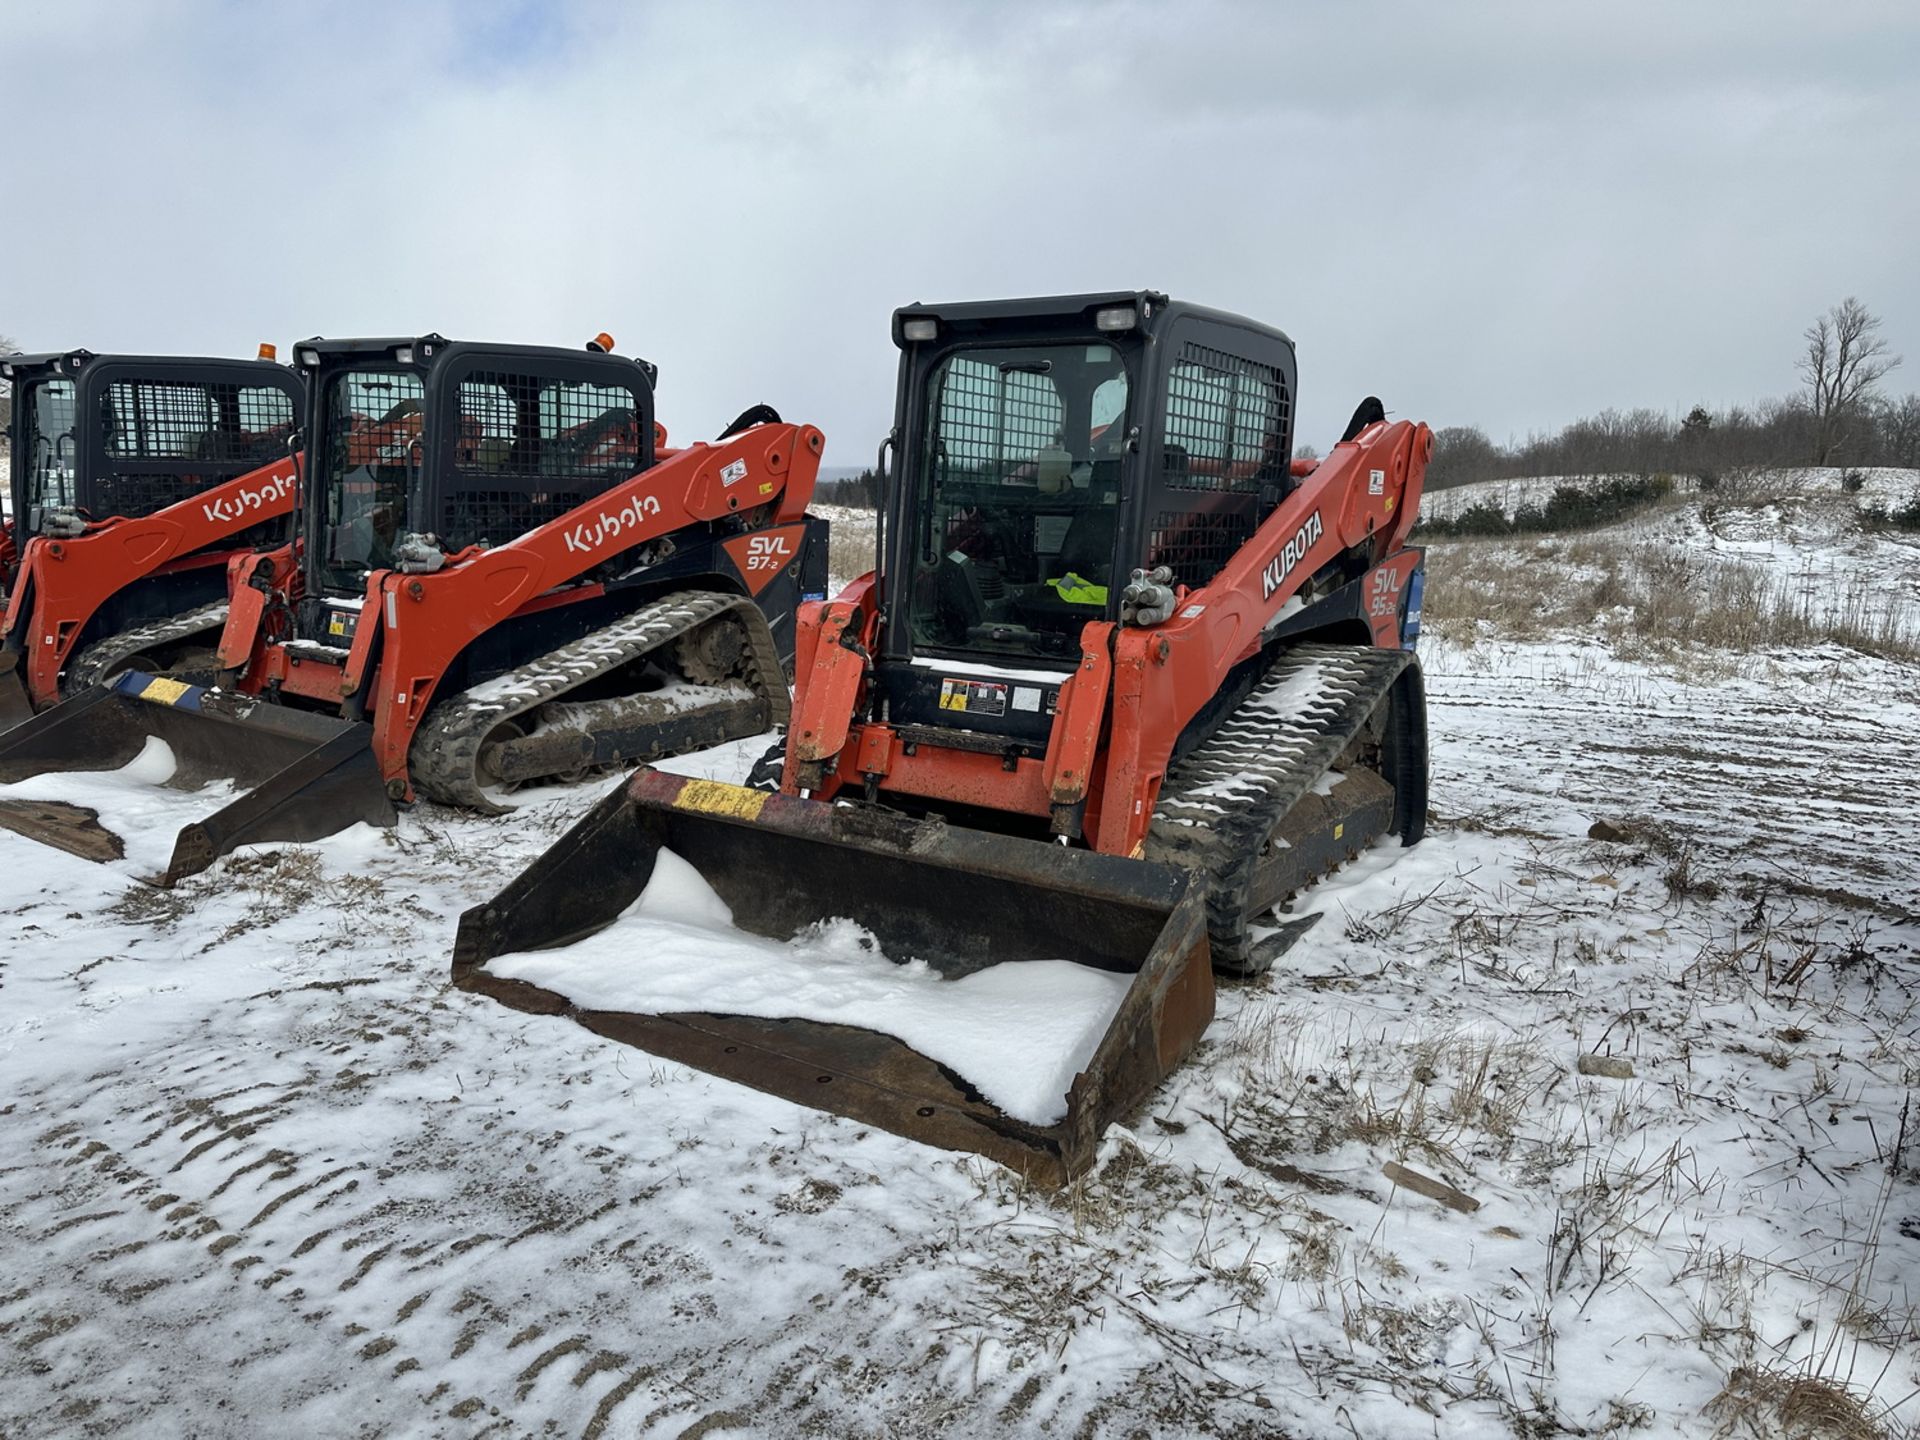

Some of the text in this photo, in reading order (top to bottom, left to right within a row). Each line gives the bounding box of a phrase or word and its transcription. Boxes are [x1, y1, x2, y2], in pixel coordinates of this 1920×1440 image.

[563, 495, 661, 552] Kubota
[747, 537, 790, 555] SVL
[1262, 509, 1323, 601] KUBOTA
[746, 556, 778, 570] 97-2
[1372, 568, 1399, 594] SVL
